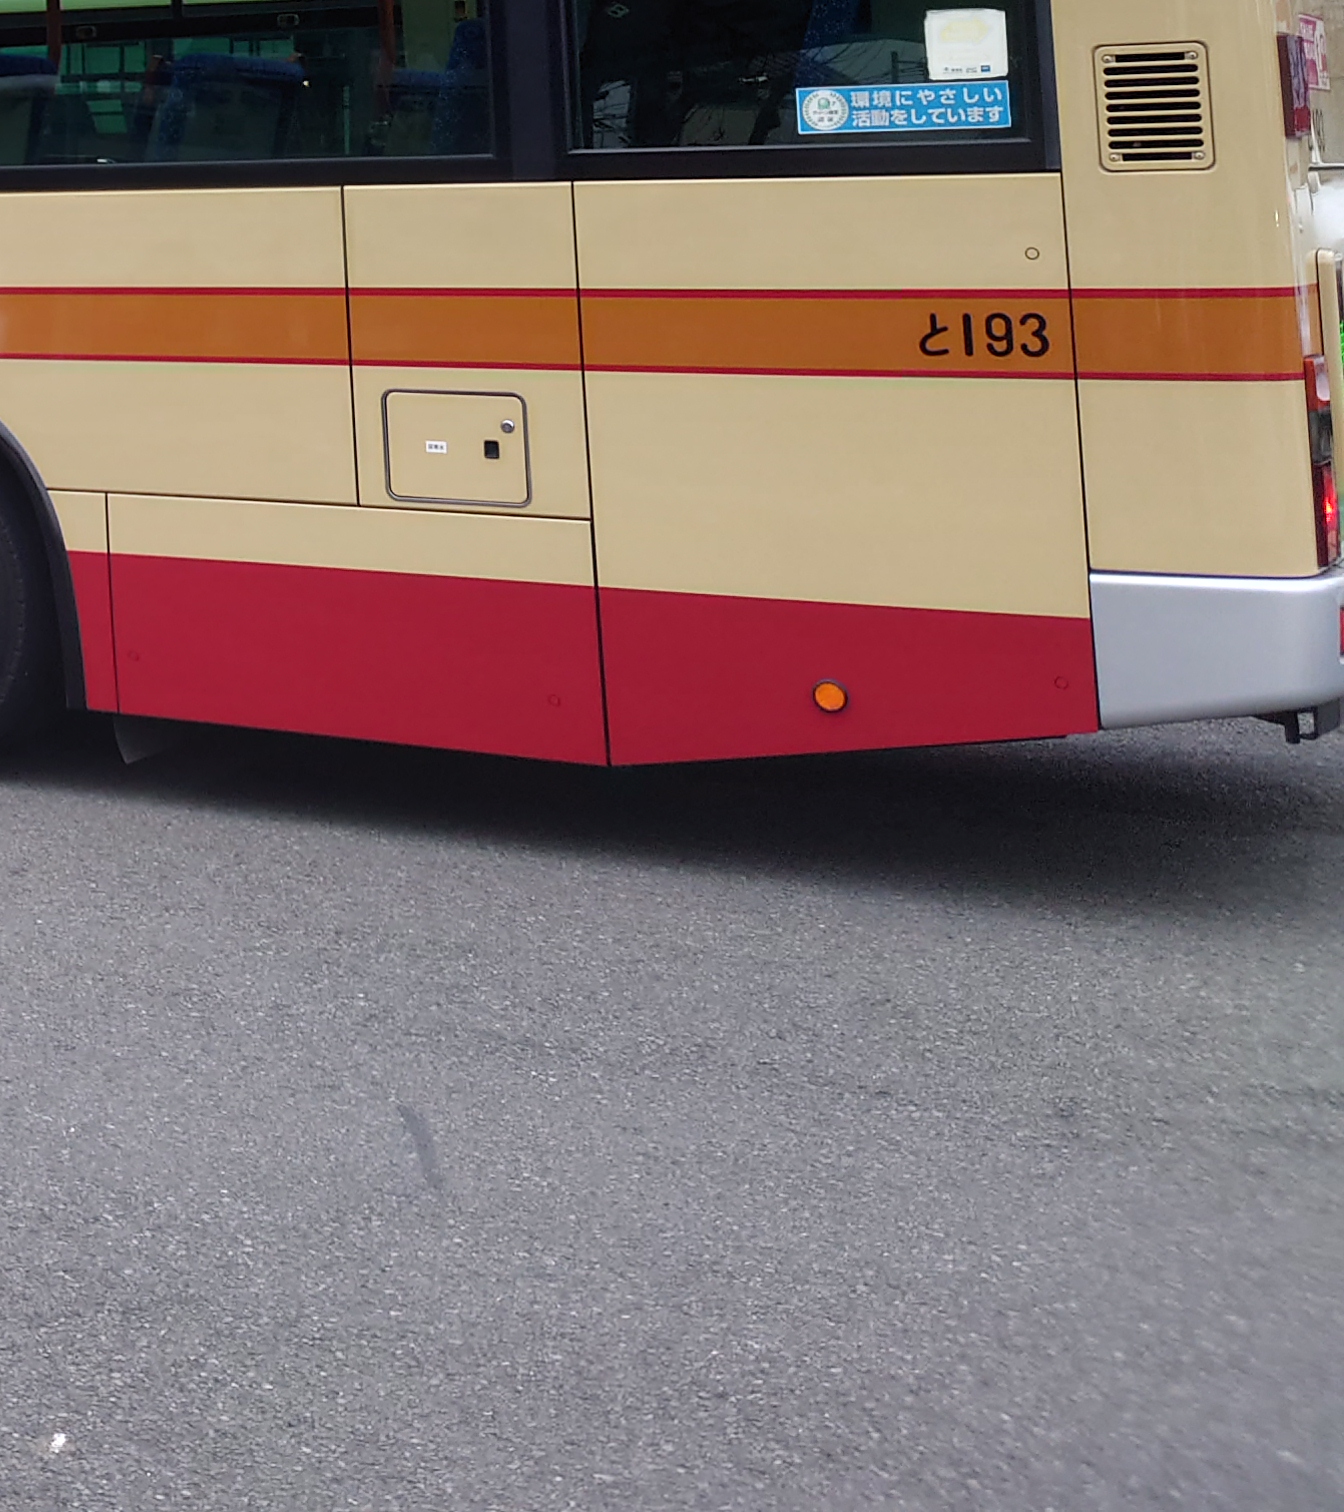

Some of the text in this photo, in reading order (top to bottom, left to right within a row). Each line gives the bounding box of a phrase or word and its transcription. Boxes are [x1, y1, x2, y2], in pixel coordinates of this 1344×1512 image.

[850, 86, 1003, 108] 環境にやさしい
[851, 105, 1004, 128] 活動をしています
[919, 312, 1050, 357] と193
